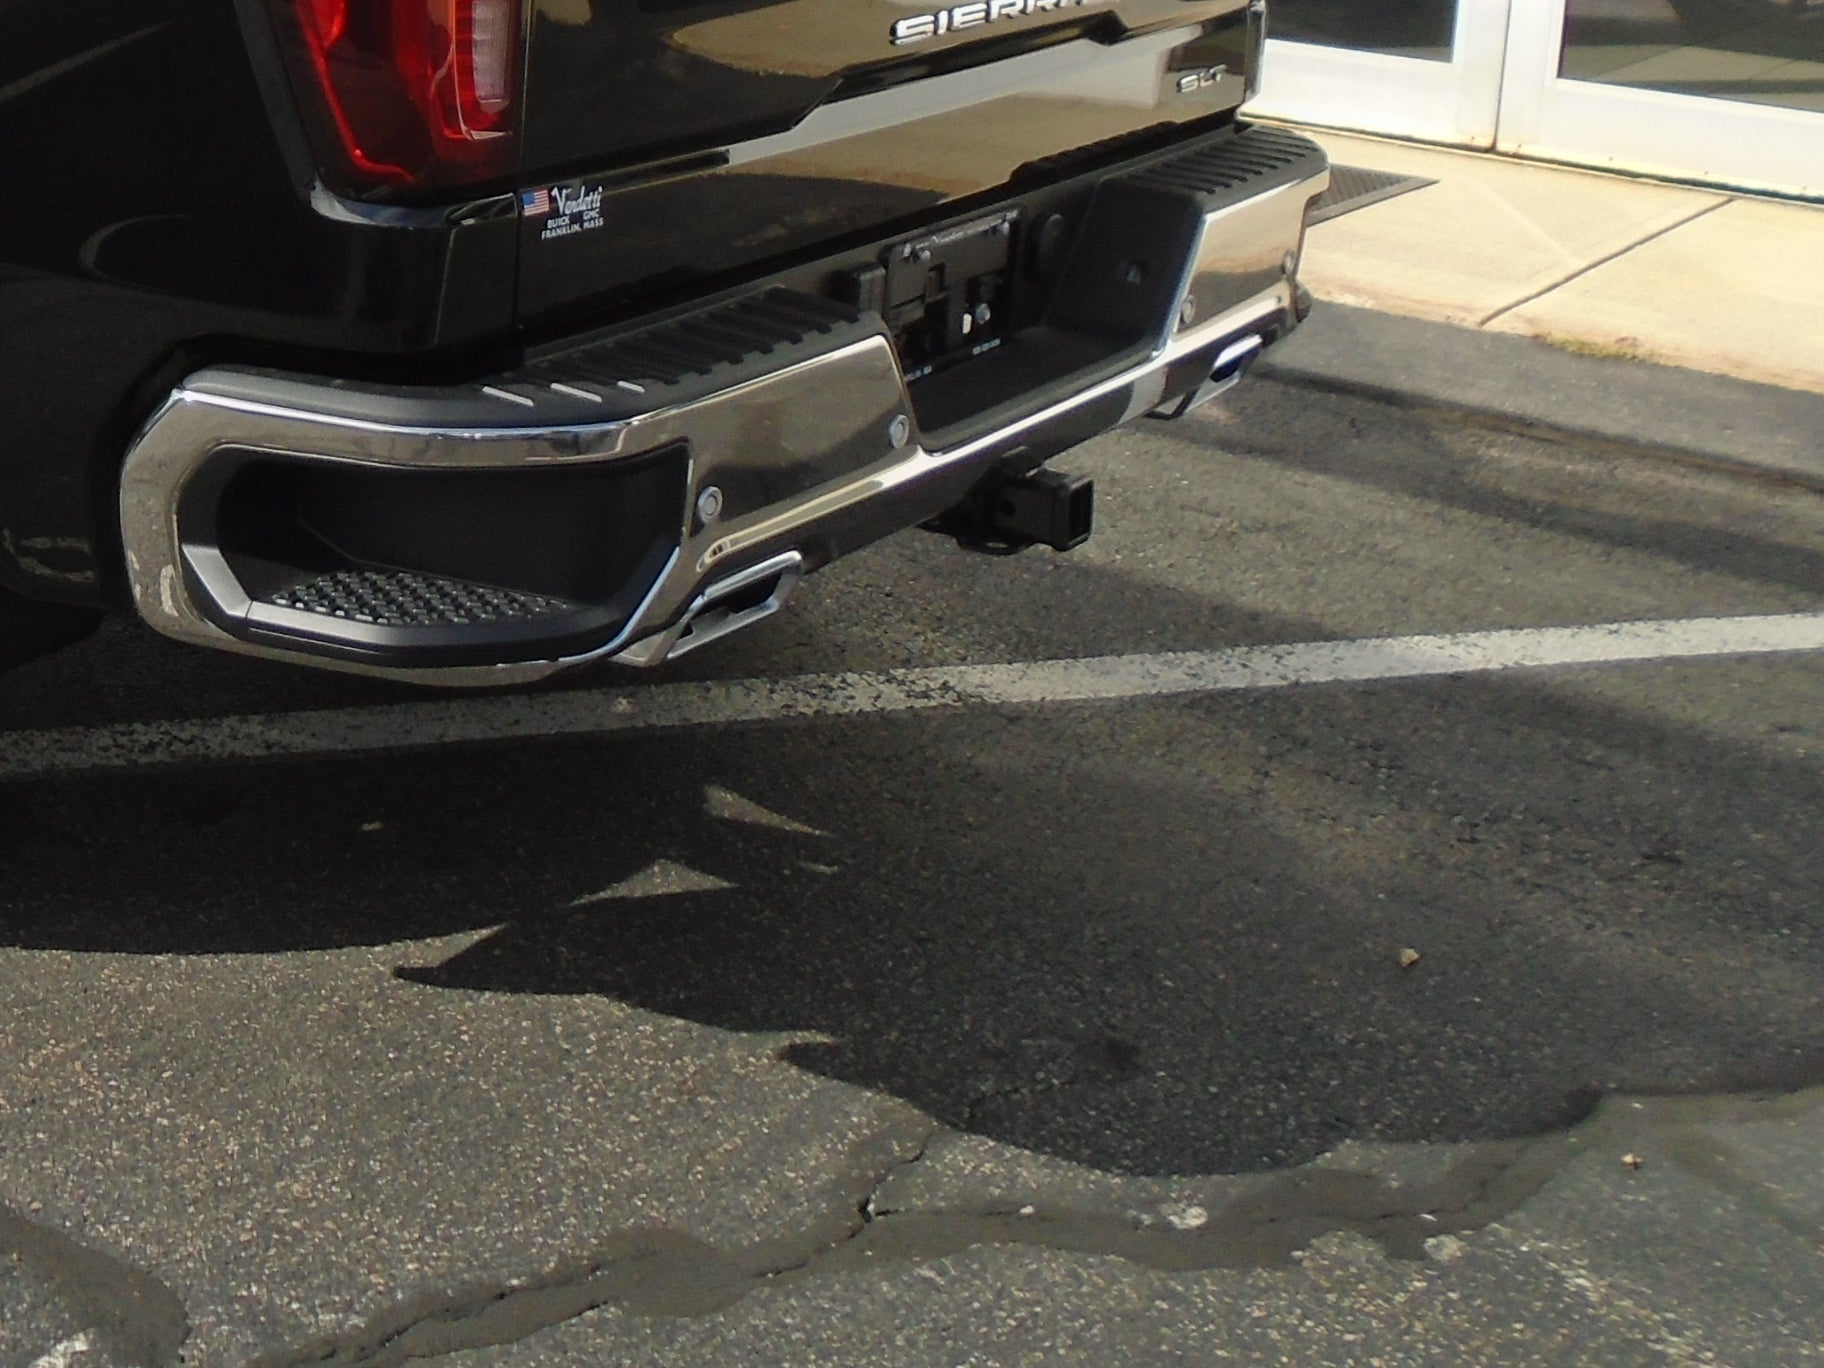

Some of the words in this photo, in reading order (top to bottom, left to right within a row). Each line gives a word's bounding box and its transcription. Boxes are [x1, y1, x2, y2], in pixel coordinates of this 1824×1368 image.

[1176, 64, 1228, 94] SLT
[546, 215, 570, 229] BUICK
[582, 209, 600, 220] GMC
